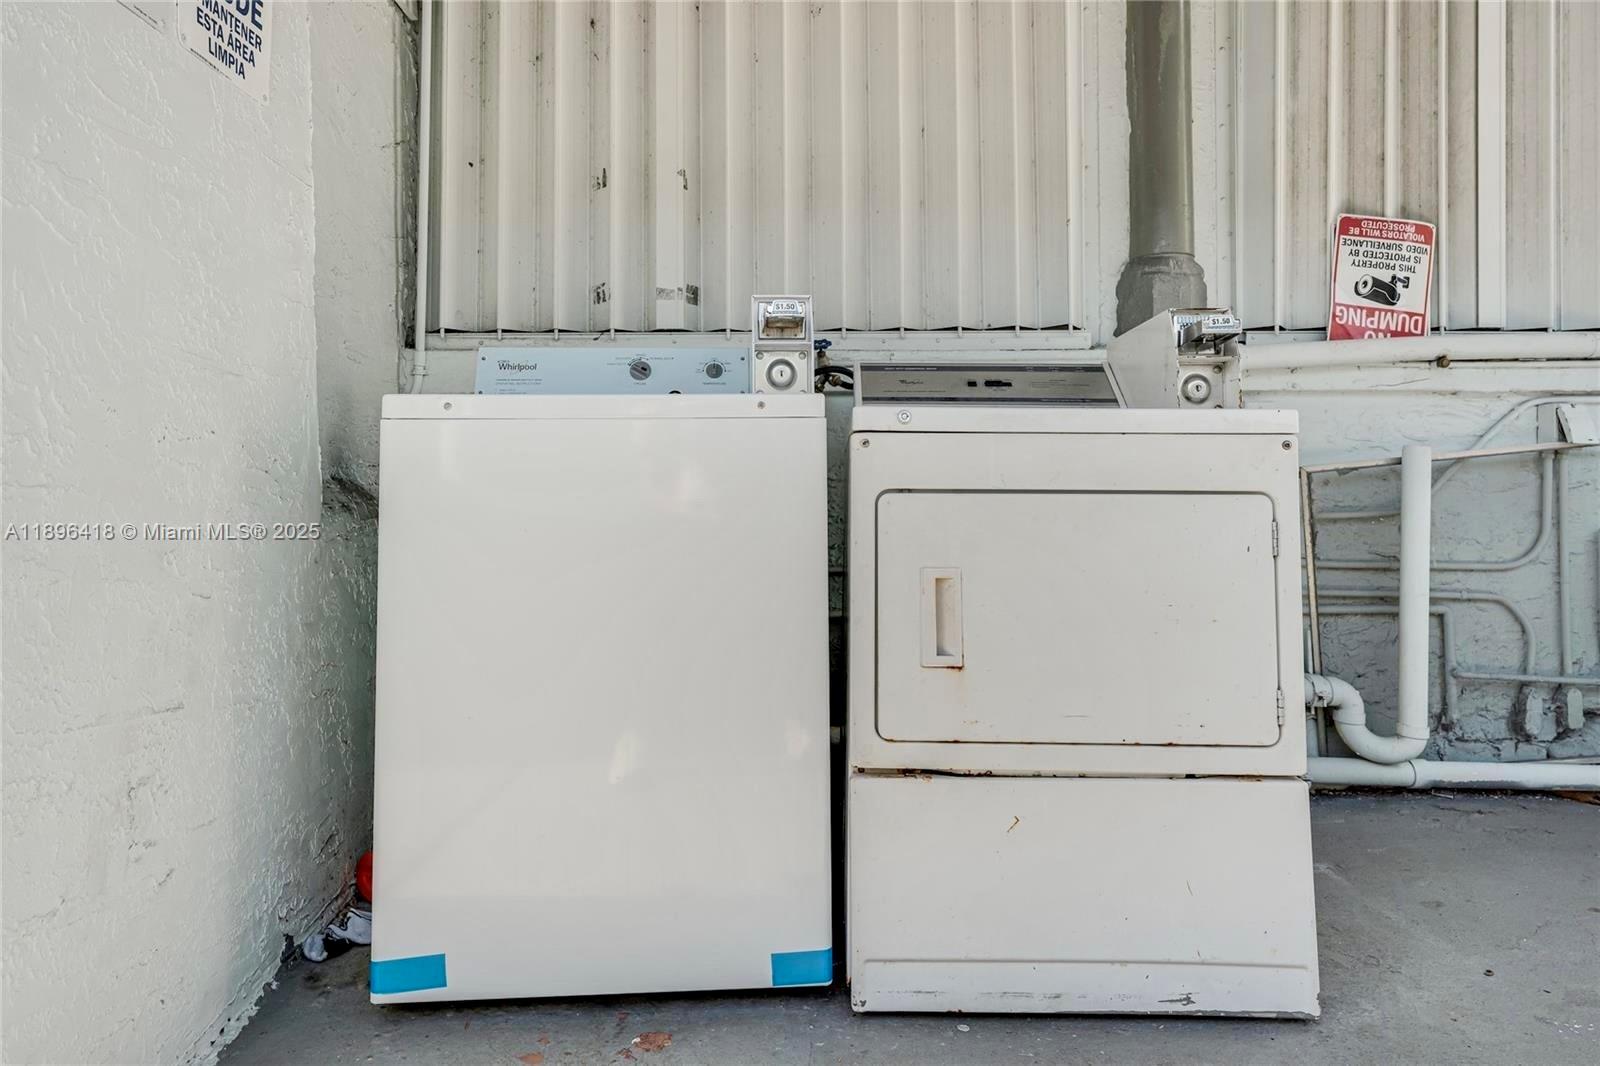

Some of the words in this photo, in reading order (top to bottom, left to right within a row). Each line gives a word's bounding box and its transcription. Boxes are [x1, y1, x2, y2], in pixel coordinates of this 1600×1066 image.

[224, 0, 263, 31] DE
[197, 6, 224, 43] ESTA
[227, 29, 255, 67] ÁREA
[208, 36, 245, 80] LIMPIA
[1348, 226, 1360, 234] BE
[1361, 220, 1415, 232] PROSECUTED
[1361, 228, 1380, 237] WILL
[1382, 231, 1424, 242] VIOLATORS
[1342, 238, 1403, 251] SURVEILLANCE
[1406, 245, 1428, 255] VIDEO
[1348, 248, 1360, 257] BY
[1363, 250, 1412, 263] PROTECTED
[1351, 259, 1396, 272] PROPERTY
[1413, 256, 1421, 264] IS
[1398, 264, 1416, 274] THIS
[1211, 317, 1231, 325] $1.50
[1335, 305, 1423, 334] DUMPING
[498, 363, 537, 372] Whirlpool
